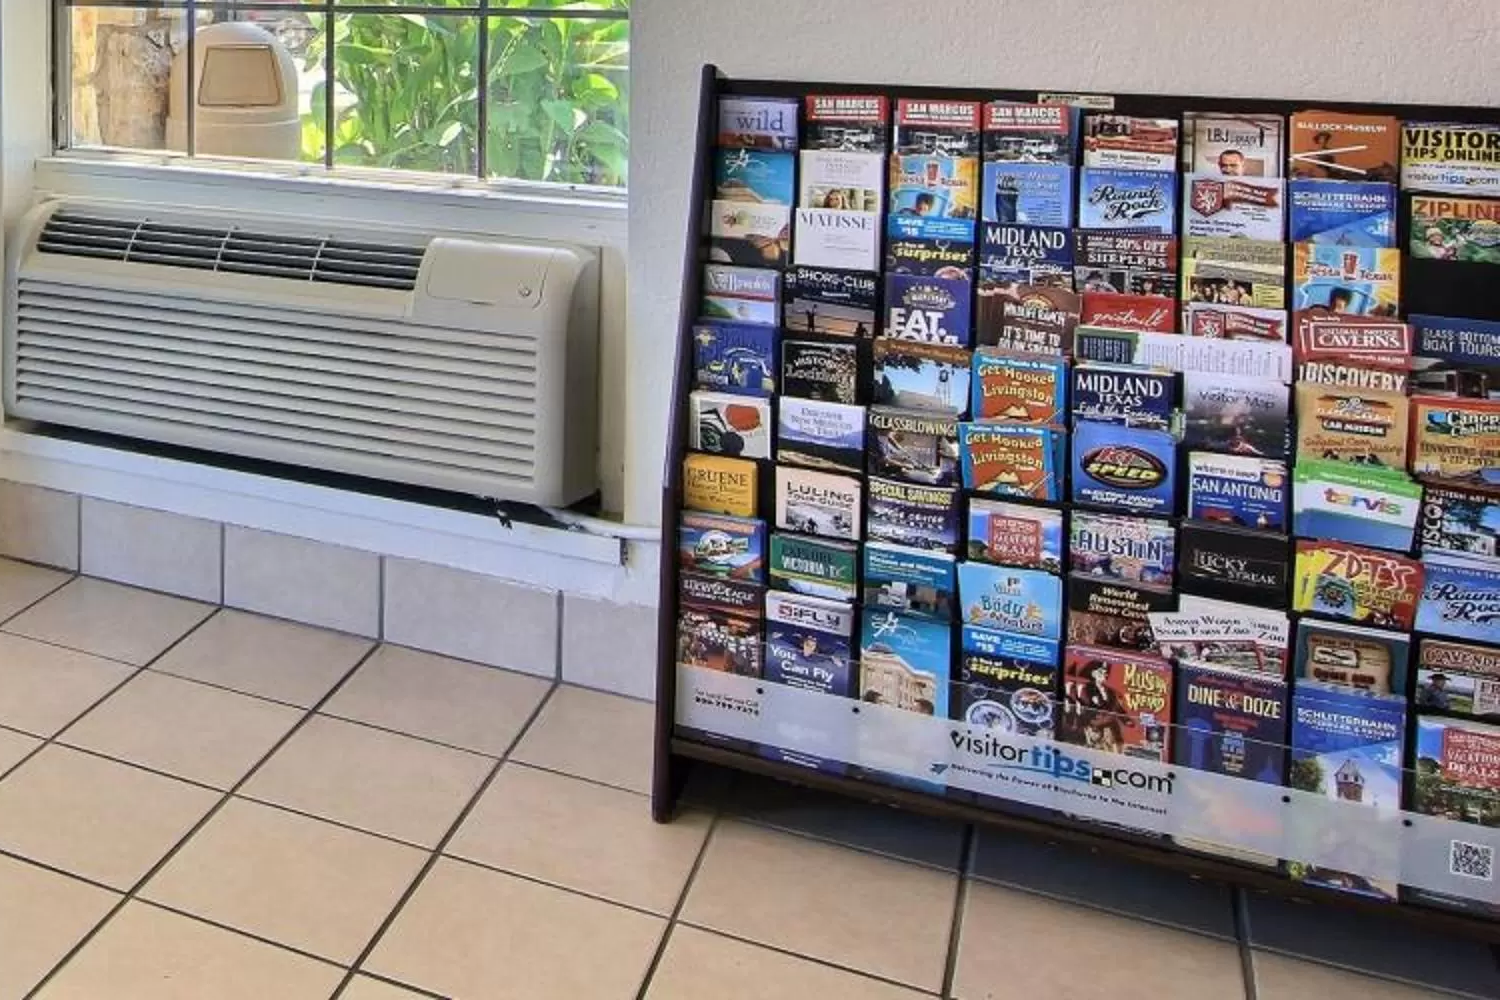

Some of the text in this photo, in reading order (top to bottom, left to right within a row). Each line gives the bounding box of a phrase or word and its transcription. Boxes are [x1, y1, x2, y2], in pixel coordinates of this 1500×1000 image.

[906, 103, 926, 113] SAN
[991, 106, 1013, 117] SAN
[736, 110, 784, 132] wild
[1207, 127, 1229, 143] LBJ
[1405, 129, 1500, 149] VISITOR
[1405, 147, 1500, 162] TIPS ONLINE
[1088, 184, 1158, 204] Round
[1104, 200, 1162, 220] Rock
[801, 212, 873, 231] MATISSE
[985, 226, 1066, 249] MIDLAND
[897, 247, 967, 262] surprises
[1005, 245, 1047, 258] TEXAS
[1318, 335, 1400, 348] CAVERNS
[1423, 340, 1455, 353] BOAT
[1460, 342, 1500, 357] TOURS
[977, 363, 1055, 384] Get Hooked
[1305, 362, 1406, 391] DISCOVERY
[981, 383, 1053, 405] Livingston
[1076, 374, 1163, 398] MIDLAND
[1098, 392, 1143, 407] TEXAS
[1245, 395, 1275, 408] Map
[1447, 410, 1500, 426] Canop
[965, 432, 1043, 449] Get Hooked
[971, 452, 1043, 470] Livingston
[687, 467, 748, 487] GRUENE
[1086, 463, 1160, 479] SPEED
[787, 481, 855, 503] LULING
[869, 481, 906, 499] SPECIAL
[1192, 478, 1283, 503] SAN ANTONIO
[1079, 530, 1164, 562] AUSTIN
[781, 556, 825, 576] VICTORIA
[1194, 550, 1248, 571] LUCKY
[1227, 570, 1277, 585] STREAK
[1101, 586, 1139, 600] World
[981, 596, 1026, 618] Body
[1088, 603, 1119, 615] Show
[1089, 594, 1150, 612] Renowned
[770, 644, 797, 661] You
[781, 660, 809, 676] Can
[812, 667, 835, 683] Fly
[970, 662, 1051, 686] surprises
[1187, 684, 1281, 719] DINE & DOZE
[1297, 707, 1397, 731] SCHLITTERBAHN
